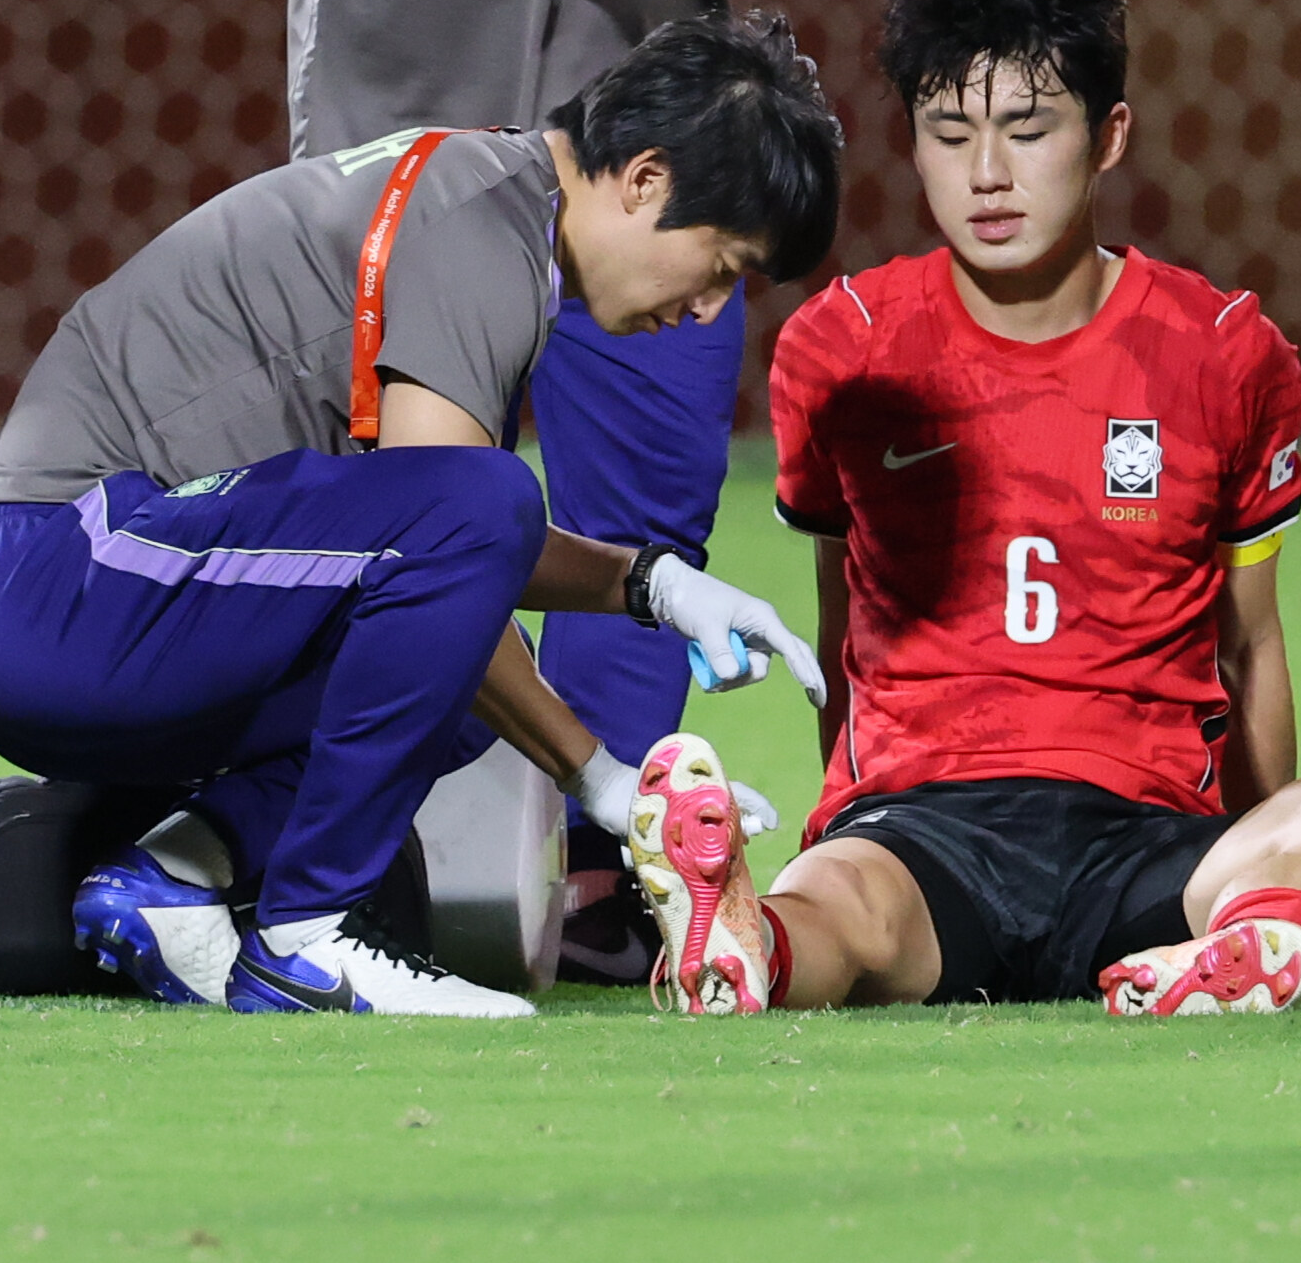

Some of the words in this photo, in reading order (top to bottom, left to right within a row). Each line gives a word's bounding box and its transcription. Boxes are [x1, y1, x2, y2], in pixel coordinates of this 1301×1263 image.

[368, 187, 402, 263] Aichi-Nagoya
[364, 265, 377, 298] 2026
[1101, 505, 1159, 523] KOREA
[1004, 536, 1060, 644] 6
